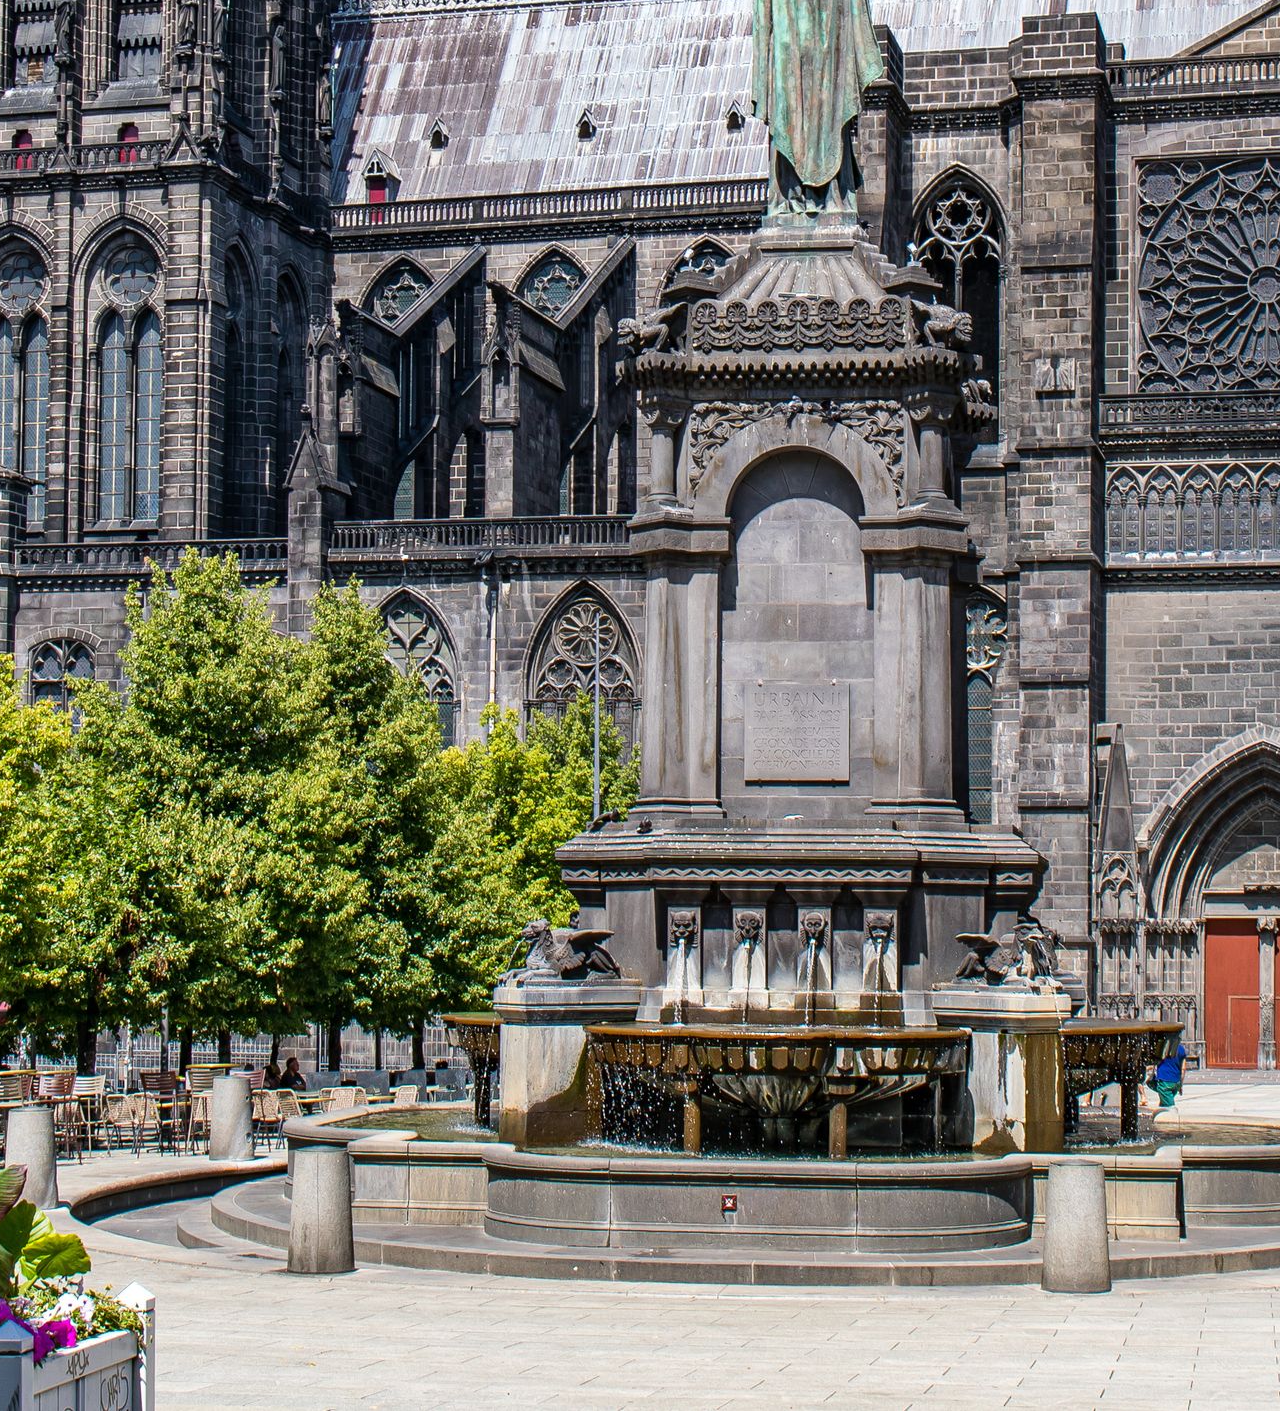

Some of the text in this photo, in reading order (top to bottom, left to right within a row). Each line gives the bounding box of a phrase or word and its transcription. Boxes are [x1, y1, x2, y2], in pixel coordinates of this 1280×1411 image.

[754, 692, 841, 707] URBAIN II
[753, 738, 841, 749] CROISADE LORS
[753, 749, 841, 759] DU CONCILE DE
